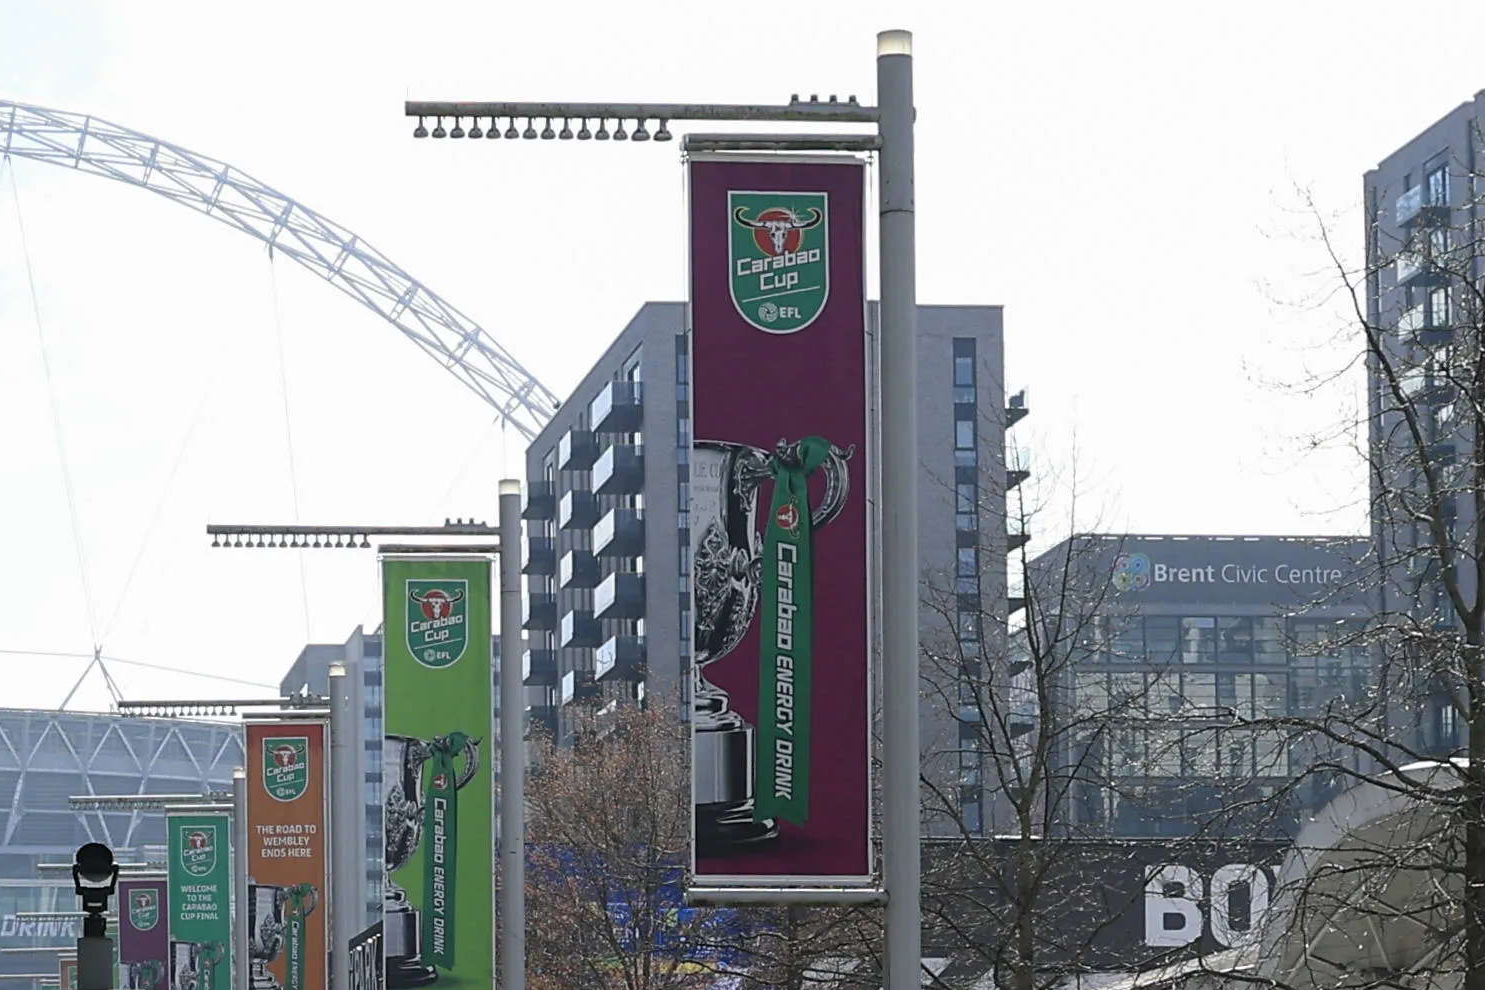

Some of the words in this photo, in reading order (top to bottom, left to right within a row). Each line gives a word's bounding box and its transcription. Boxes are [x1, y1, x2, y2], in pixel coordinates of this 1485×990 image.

[736, 248, 821, 276] Carabao
[759, 271, 799, 291] Cup
[779, 307, 802, 319] EFL
[1154, 564, 1215, 582] Brent
[1221, 563, 1268, 584] Civic
[1274, 564, 1342, 584] Centre
[775, 541, 797, 651] Carabao
[410, 614, 464, 633] Carabao
[424, 629, 449, 642] Cup
[436, 651, 451, 660] EFL
[775, 654, 794, 736] ENERGY
[266, 761, 305, 777] Carabao
[774, 738, 793, 801] DRINK
[276, 773, 295, 783] Cup
[256, 825, 275, 835] THE
[276, 824, 303, 835] ROAD
[304, 824, 317, 834] TO
[433, 796, 447, 863] Carabao
[263, 836, 311, 846] WEMBLEY
[261, 848, 286, 858] ENDS
[287, 848, 313, 858] HERE
[180, 885, 218, 894] WELCOME
[433, 866, 445, 916] ENERGY
[186, 894, 198, 903] TO
[198, 894, 213, 903] THE
[181, 903, 218, 912] CARABAO
[0, 912, 76, 937] DRINK
[180, 912, 196, 921] CUP
[196, 912, 219, 921] FINAL
[432, 917, 445, 956] DRINK
